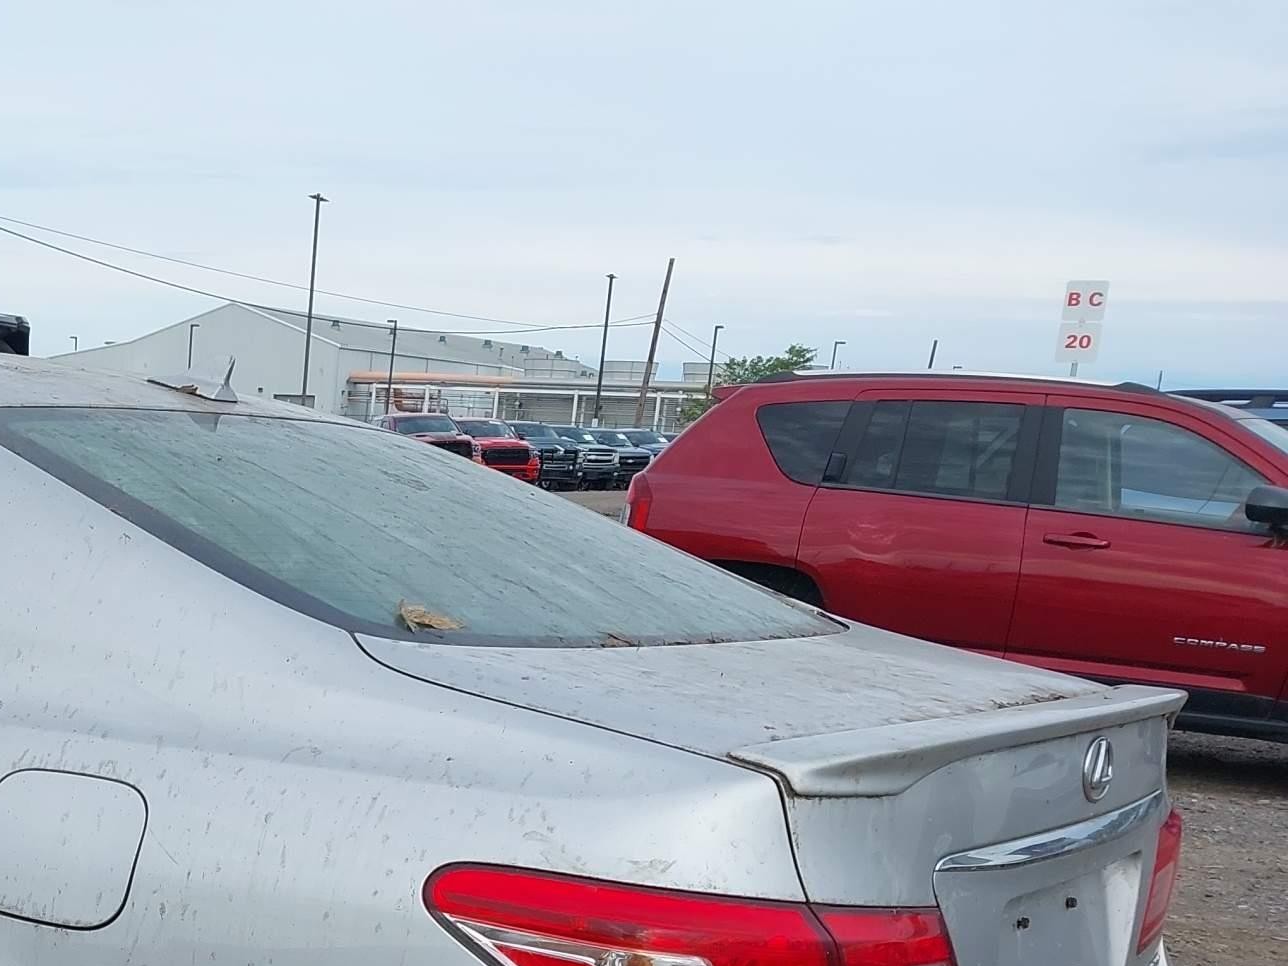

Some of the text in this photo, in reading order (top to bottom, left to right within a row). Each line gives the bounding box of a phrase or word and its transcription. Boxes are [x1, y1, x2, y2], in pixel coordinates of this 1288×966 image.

[1067, 292, 1104, 307] B C
[1065, 334, 1092, 349] 20
[1173, 636, 1266, 653] COMPASS
